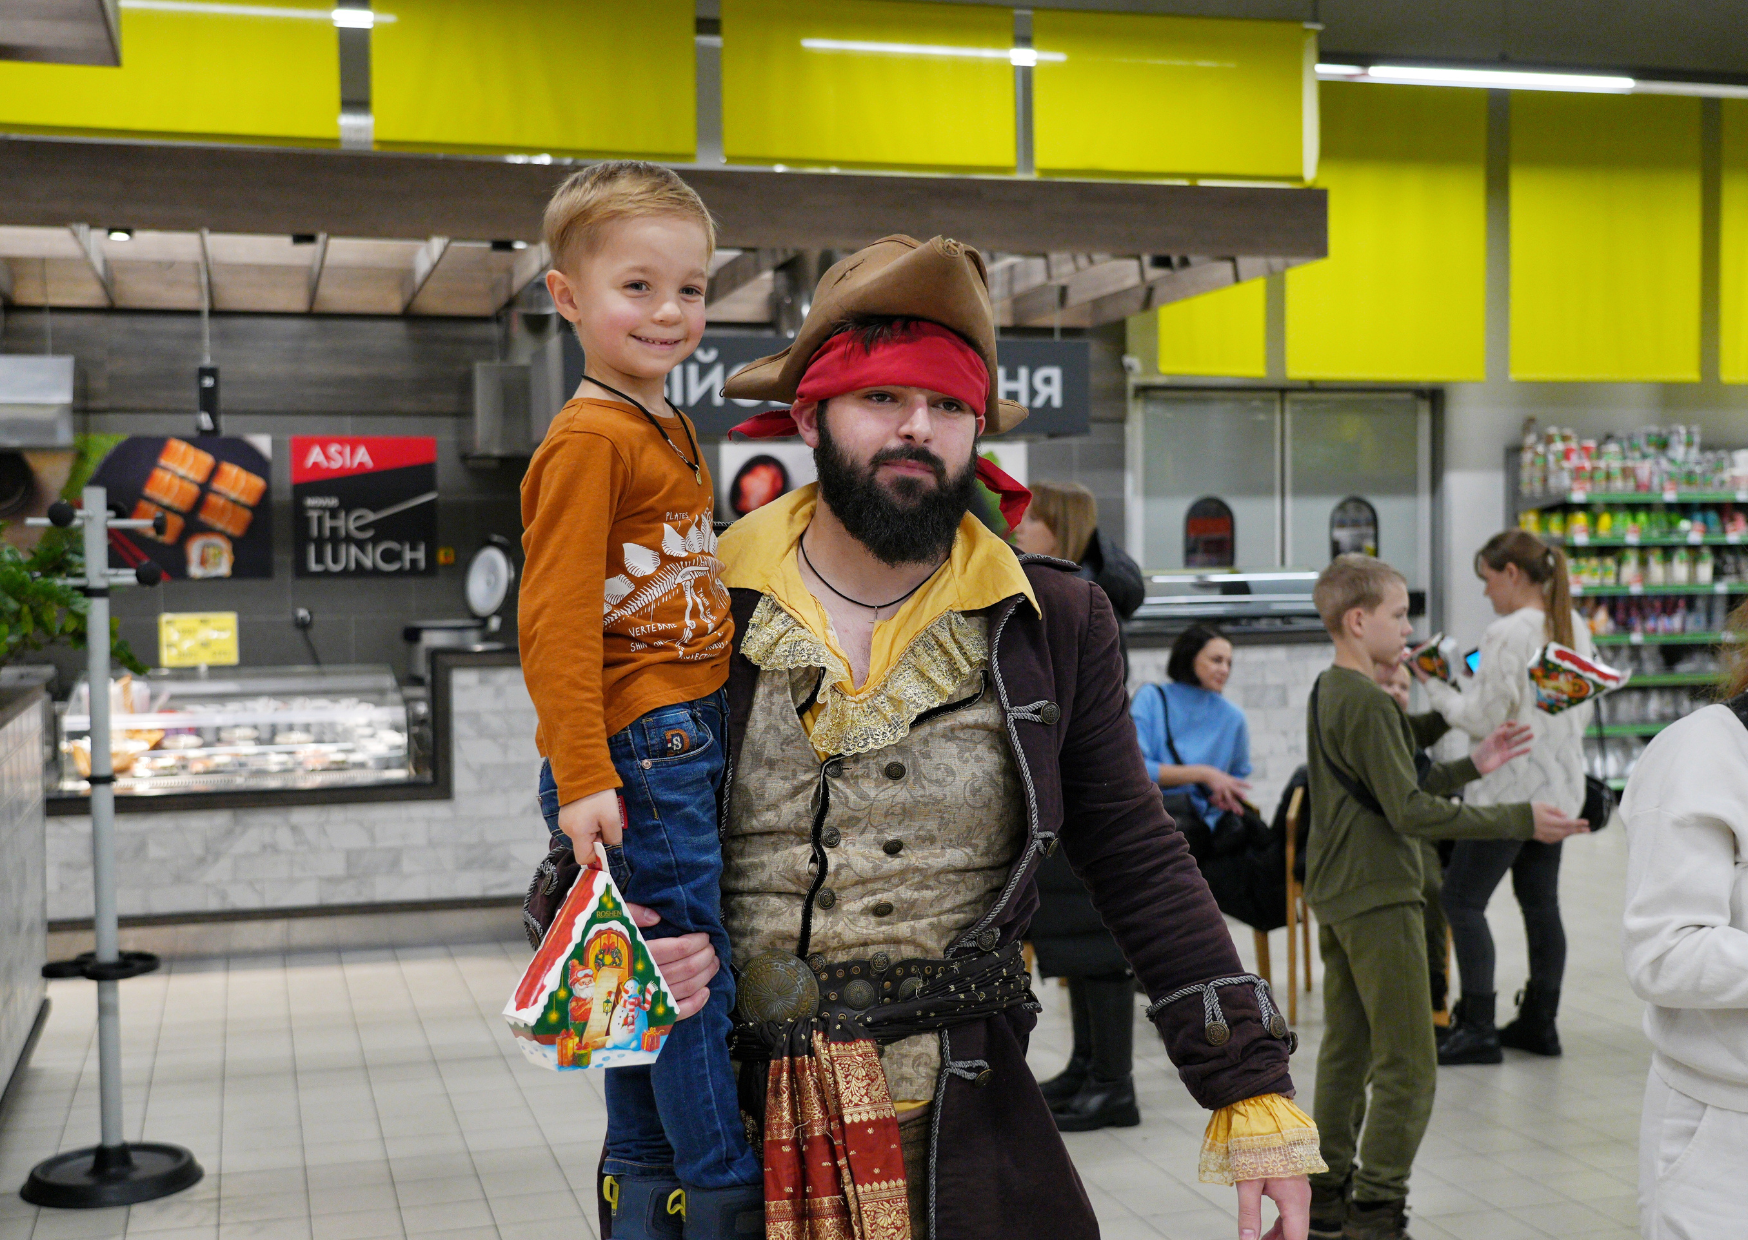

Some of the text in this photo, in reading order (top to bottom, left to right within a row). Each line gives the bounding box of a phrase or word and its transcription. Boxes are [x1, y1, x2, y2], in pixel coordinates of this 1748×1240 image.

[304, 443, 374, 469] ASIA
[665, 511, 689, 521] PLATES
[306, 540, 426, 572] LUNCH
[596, 909, 622, 918] ROSHEN
